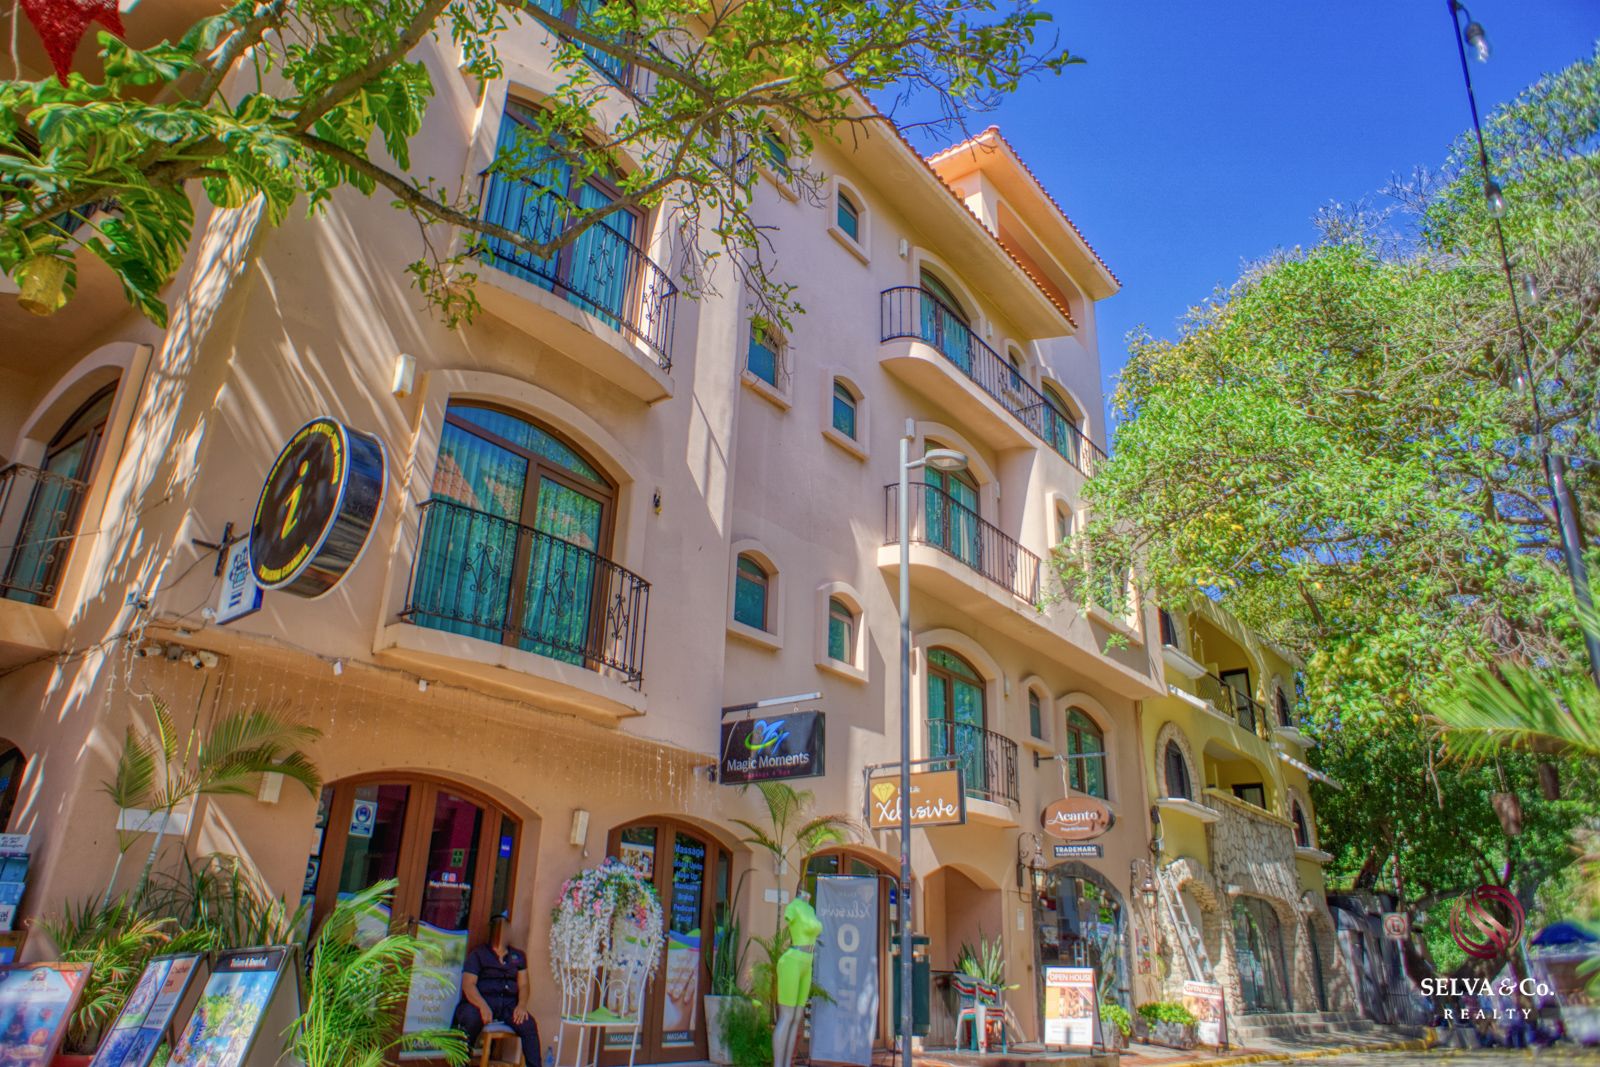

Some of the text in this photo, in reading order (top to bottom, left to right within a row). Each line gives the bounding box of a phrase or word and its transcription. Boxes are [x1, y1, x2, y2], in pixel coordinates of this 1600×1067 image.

[726, 752, 810, 772] Magic Moments
[1048, 810, 1098, 825] Acanto
[675, 844, 704, 857] Massage
[1049, 973, 1069, 982] OPEN
[666, 1032, 688, 1040] MASSAGE
